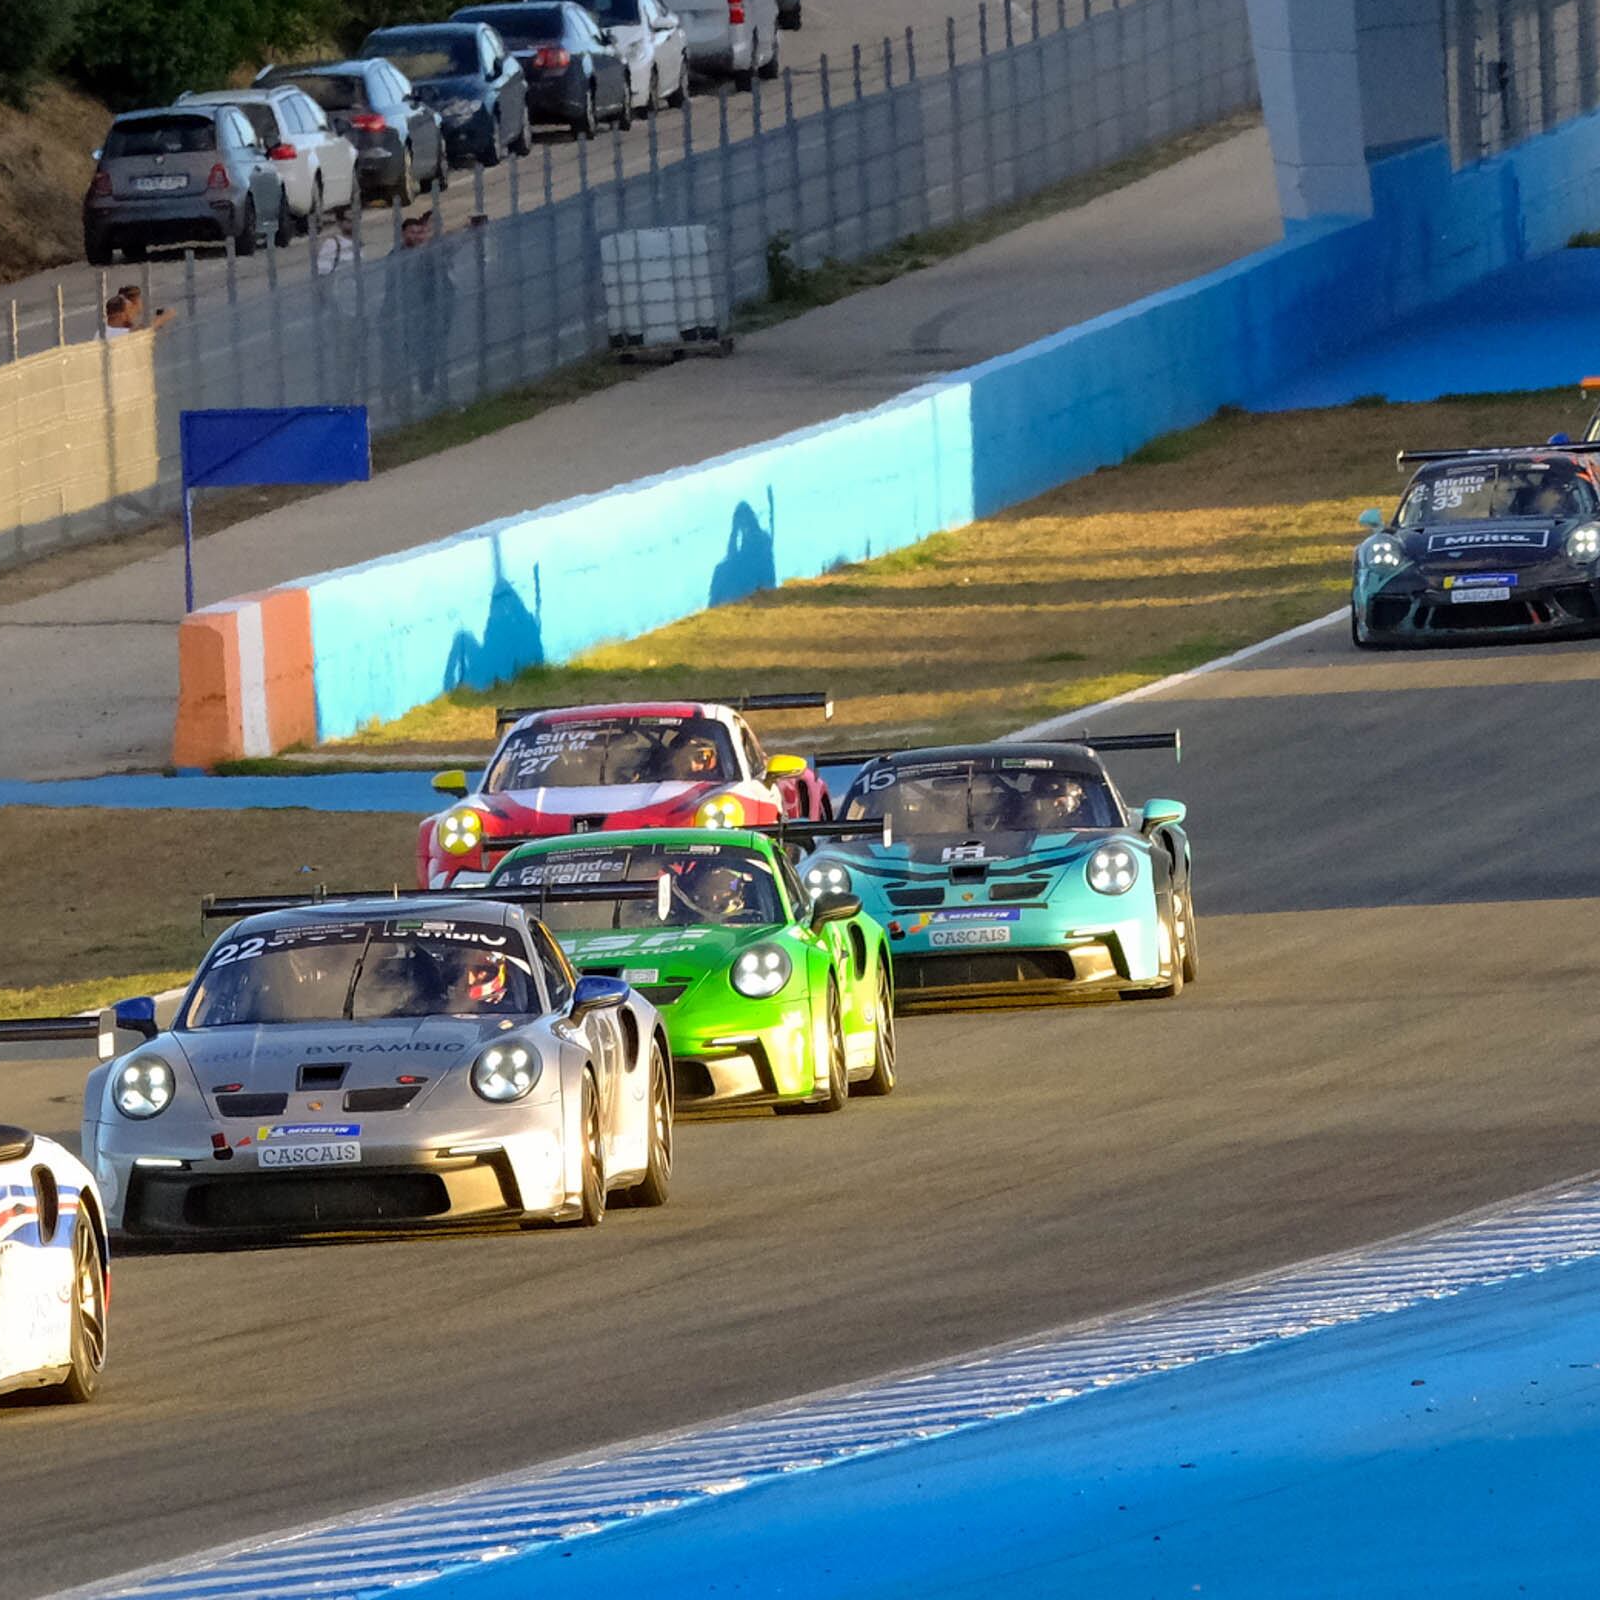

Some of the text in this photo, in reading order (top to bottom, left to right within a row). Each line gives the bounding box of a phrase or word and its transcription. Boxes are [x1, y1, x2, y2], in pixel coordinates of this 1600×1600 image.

[1434, 475, 1485, 489] Miritta
[1432, 495, 1463, 511] 33
[536, 731, 597, 745] Silva
[517, 754, 560, 777] 27
[854, 767, 897, 794] 15
[520, 860, 623, 879] Fernandes
[932, 928, 1007, 945] CASCAIS
[210, 937, 266, 970] 22
[286, 1126, 350, 1135] MICHELIN
[263, 1145, 356, 1164] CASCAIS
